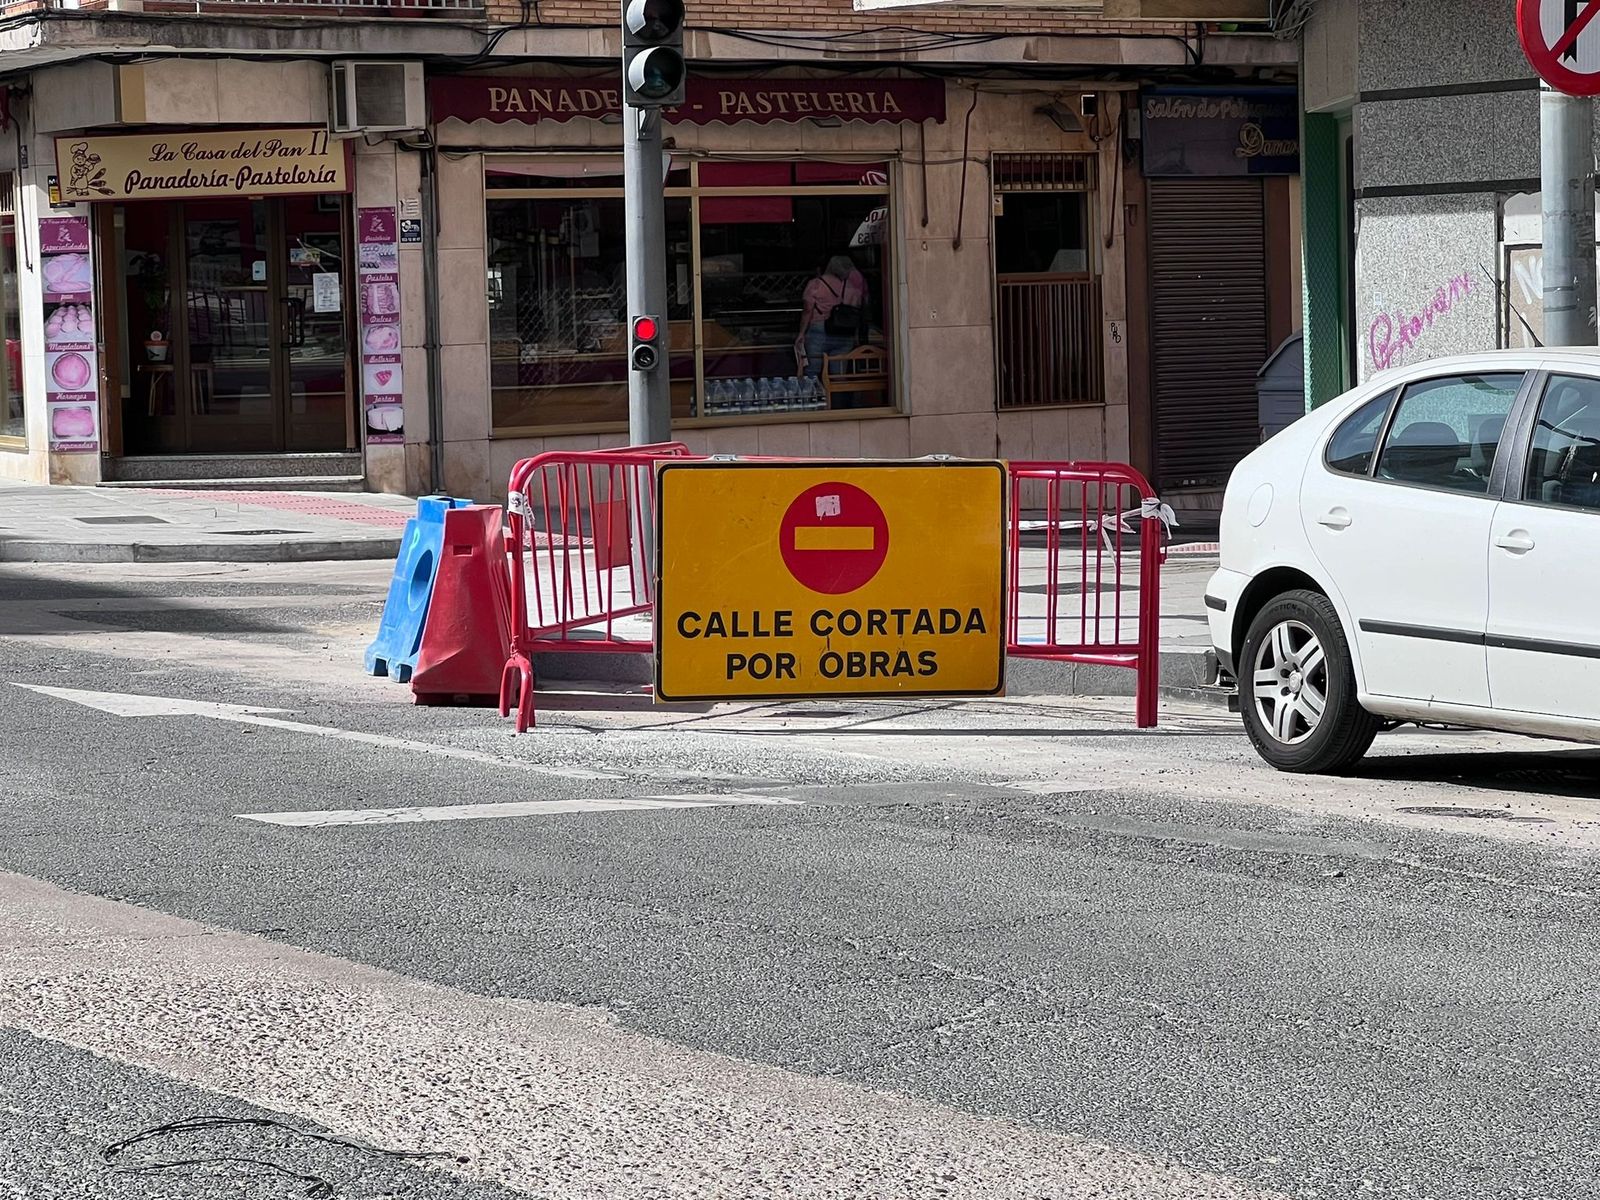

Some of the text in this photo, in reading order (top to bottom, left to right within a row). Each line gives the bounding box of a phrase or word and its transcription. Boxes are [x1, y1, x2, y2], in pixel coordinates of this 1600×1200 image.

[488, 88, 678, 113] PANADE
[719, 91, 901, 115] PASTELERIA
[149, 142, 178, 162] La
[180, 141, 227, 161] Casa
[230, 141, 262, 159] del
[263, 138, 307, 158] Pan
[123, 164, 337, 195] Panadería-Pastelería
[41, 242, 88, 253] Especialidades
[48, 341, 91, 351] Magdalenas
[677, 608, 987, 639] CALLE CORTADA
[726, 650, 939, 680] POR OBRAS
